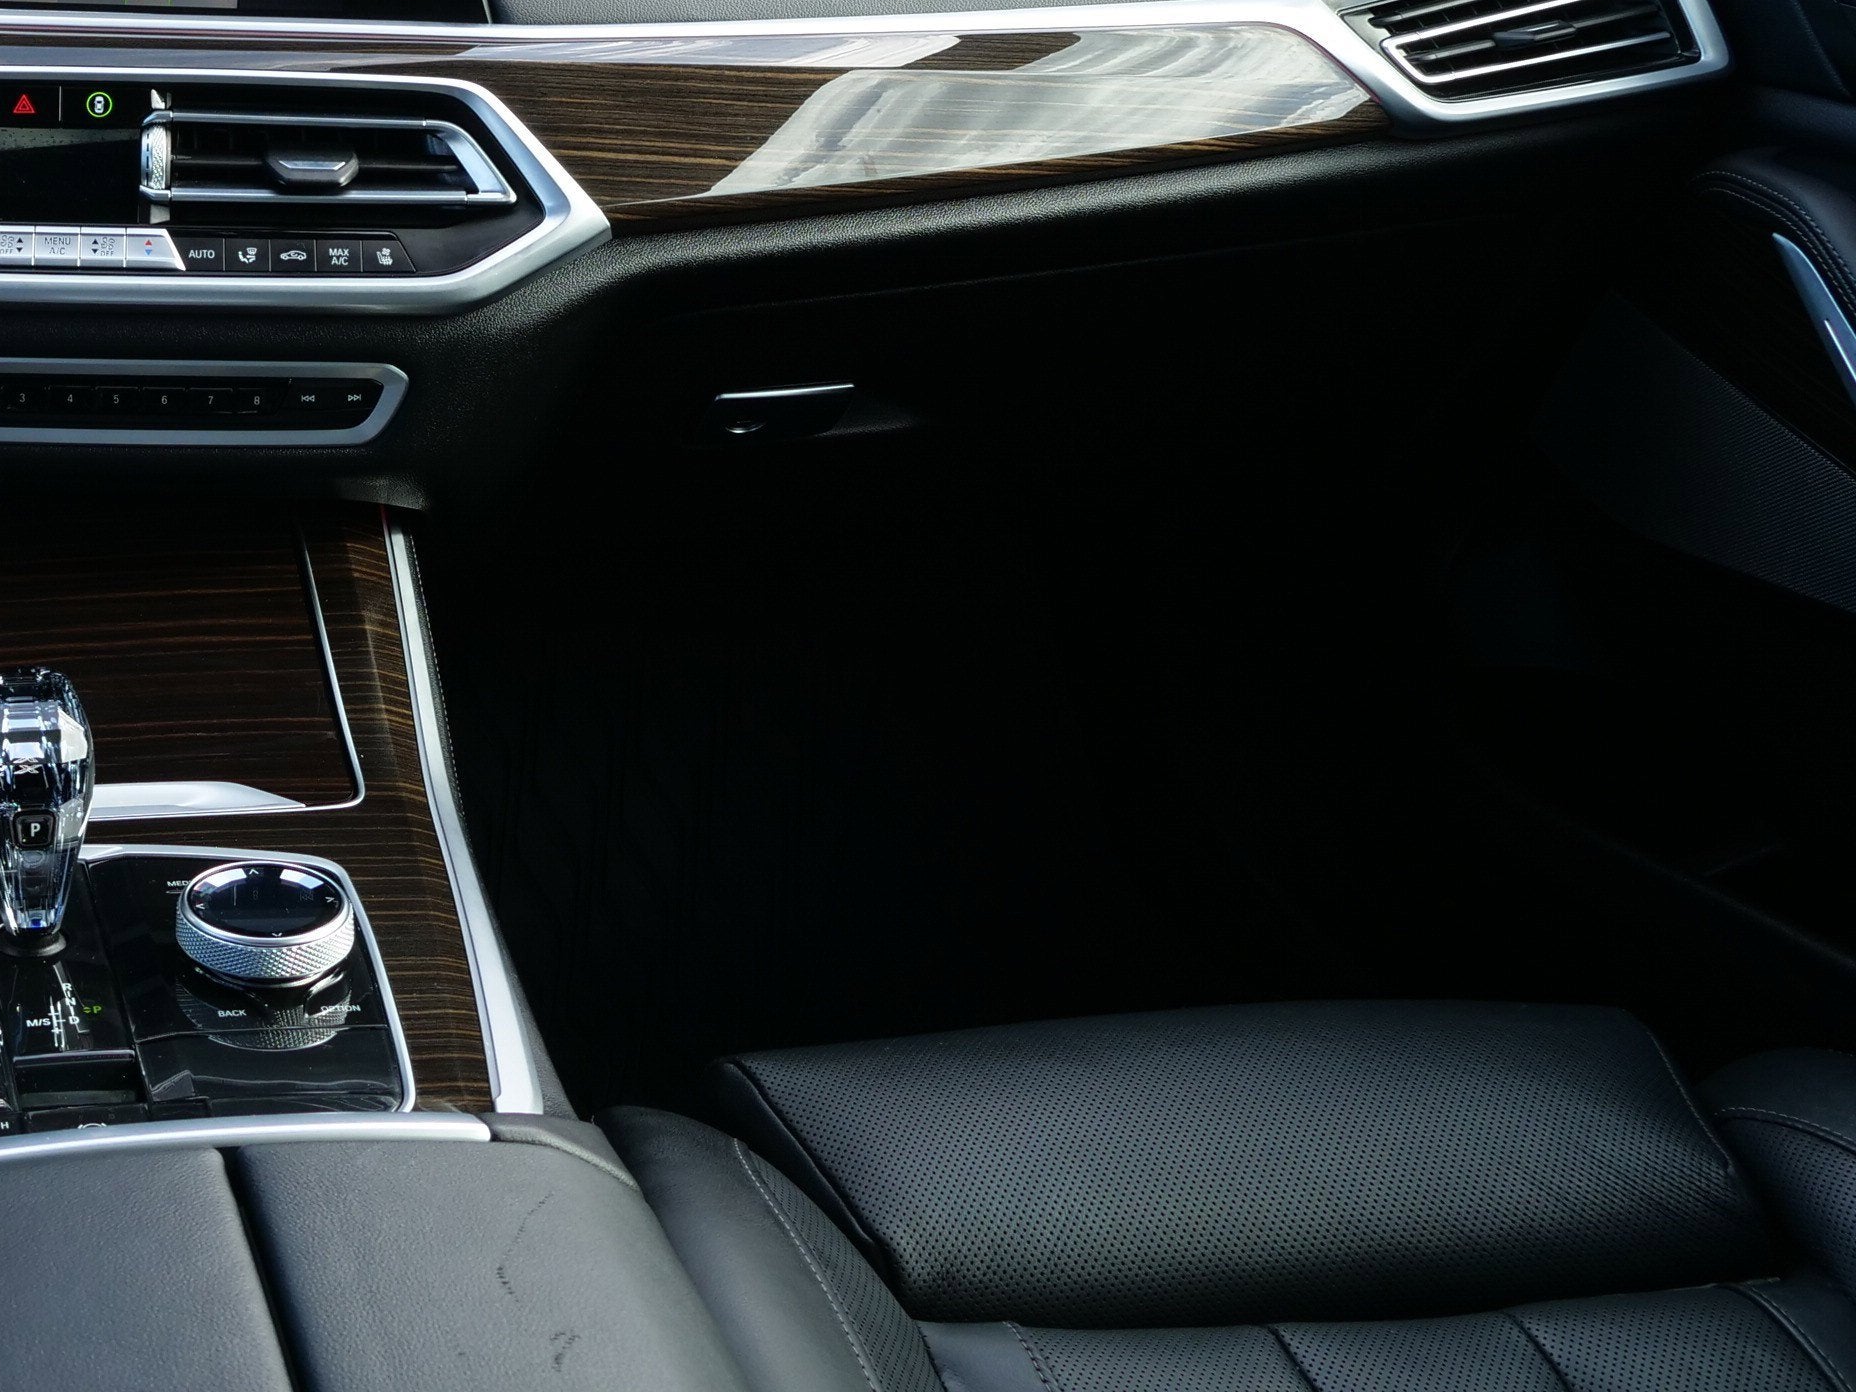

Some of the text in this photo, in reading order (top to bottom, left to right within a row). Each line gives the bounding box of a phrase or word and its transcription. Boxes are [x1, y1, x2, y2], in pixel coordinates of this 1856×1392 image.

[44, 237, 71, 246] MENU
[49, 247, 65, 255] A/C
[189, 249, 215, 259] AUTO
[329, 248, 349, 256] MAX
[331, 257, 348, 265] A/C
[19, 393, 26, 403] 3
[67, 394, 74, 404] 4
[113, 395, 119, 404] 5
[161, 395, 168, 405] 6
[208, 395, 214, 405] 7
[253, 396, 260, 406] 8
[30, 823, 41, 837] P
[62, 982, 72, 991] R
[218, 1009, 247, 1018] BACK
[320, 1005, 361, 1013] OPTION
[26, 1018, 51, 1027] M/S
[69, 1016, 80, 1025] D
[0, 1121, 9, 1129] H
